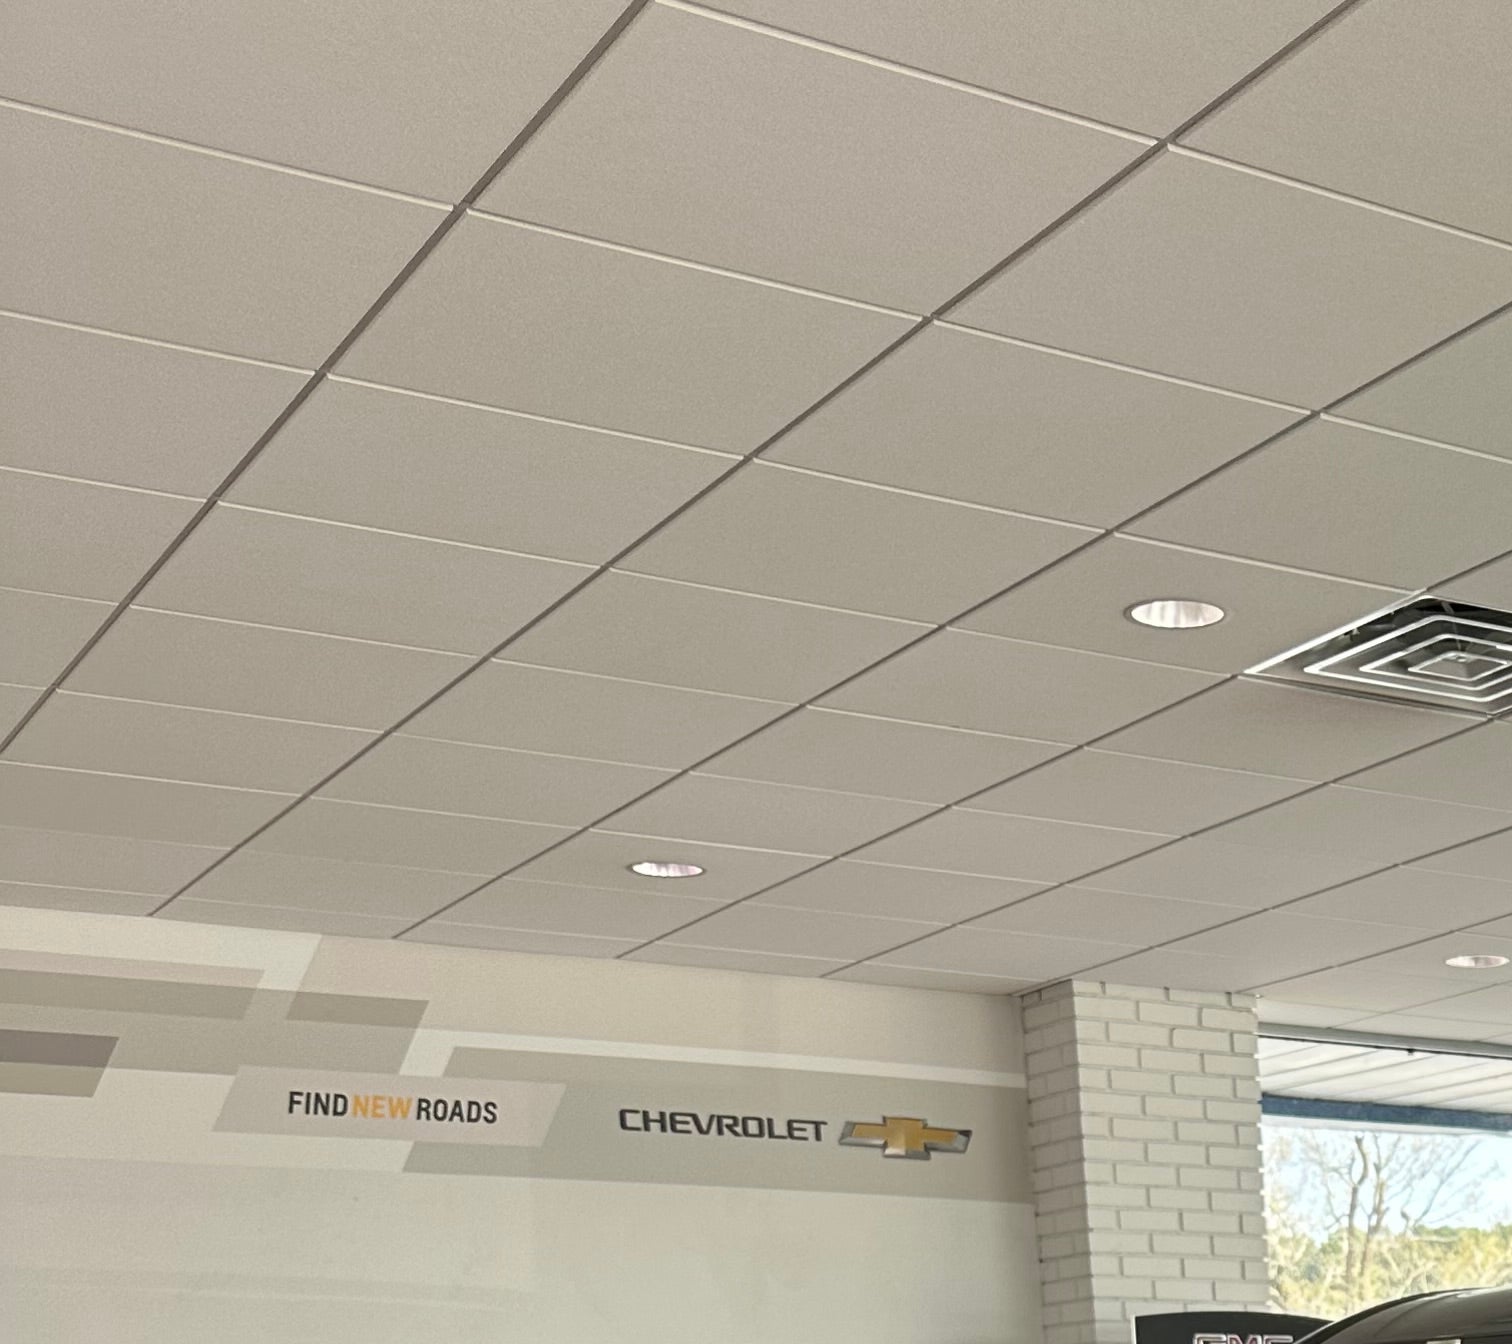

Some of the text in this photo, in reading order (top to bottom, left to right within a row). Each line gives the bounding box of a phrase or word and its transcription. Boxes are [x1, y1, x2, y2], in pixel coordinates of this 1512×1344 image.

[288, 1091, 498, 1124] FIND NEW ROADS
[619, 1108, 828, 1142] CHEVROLET
